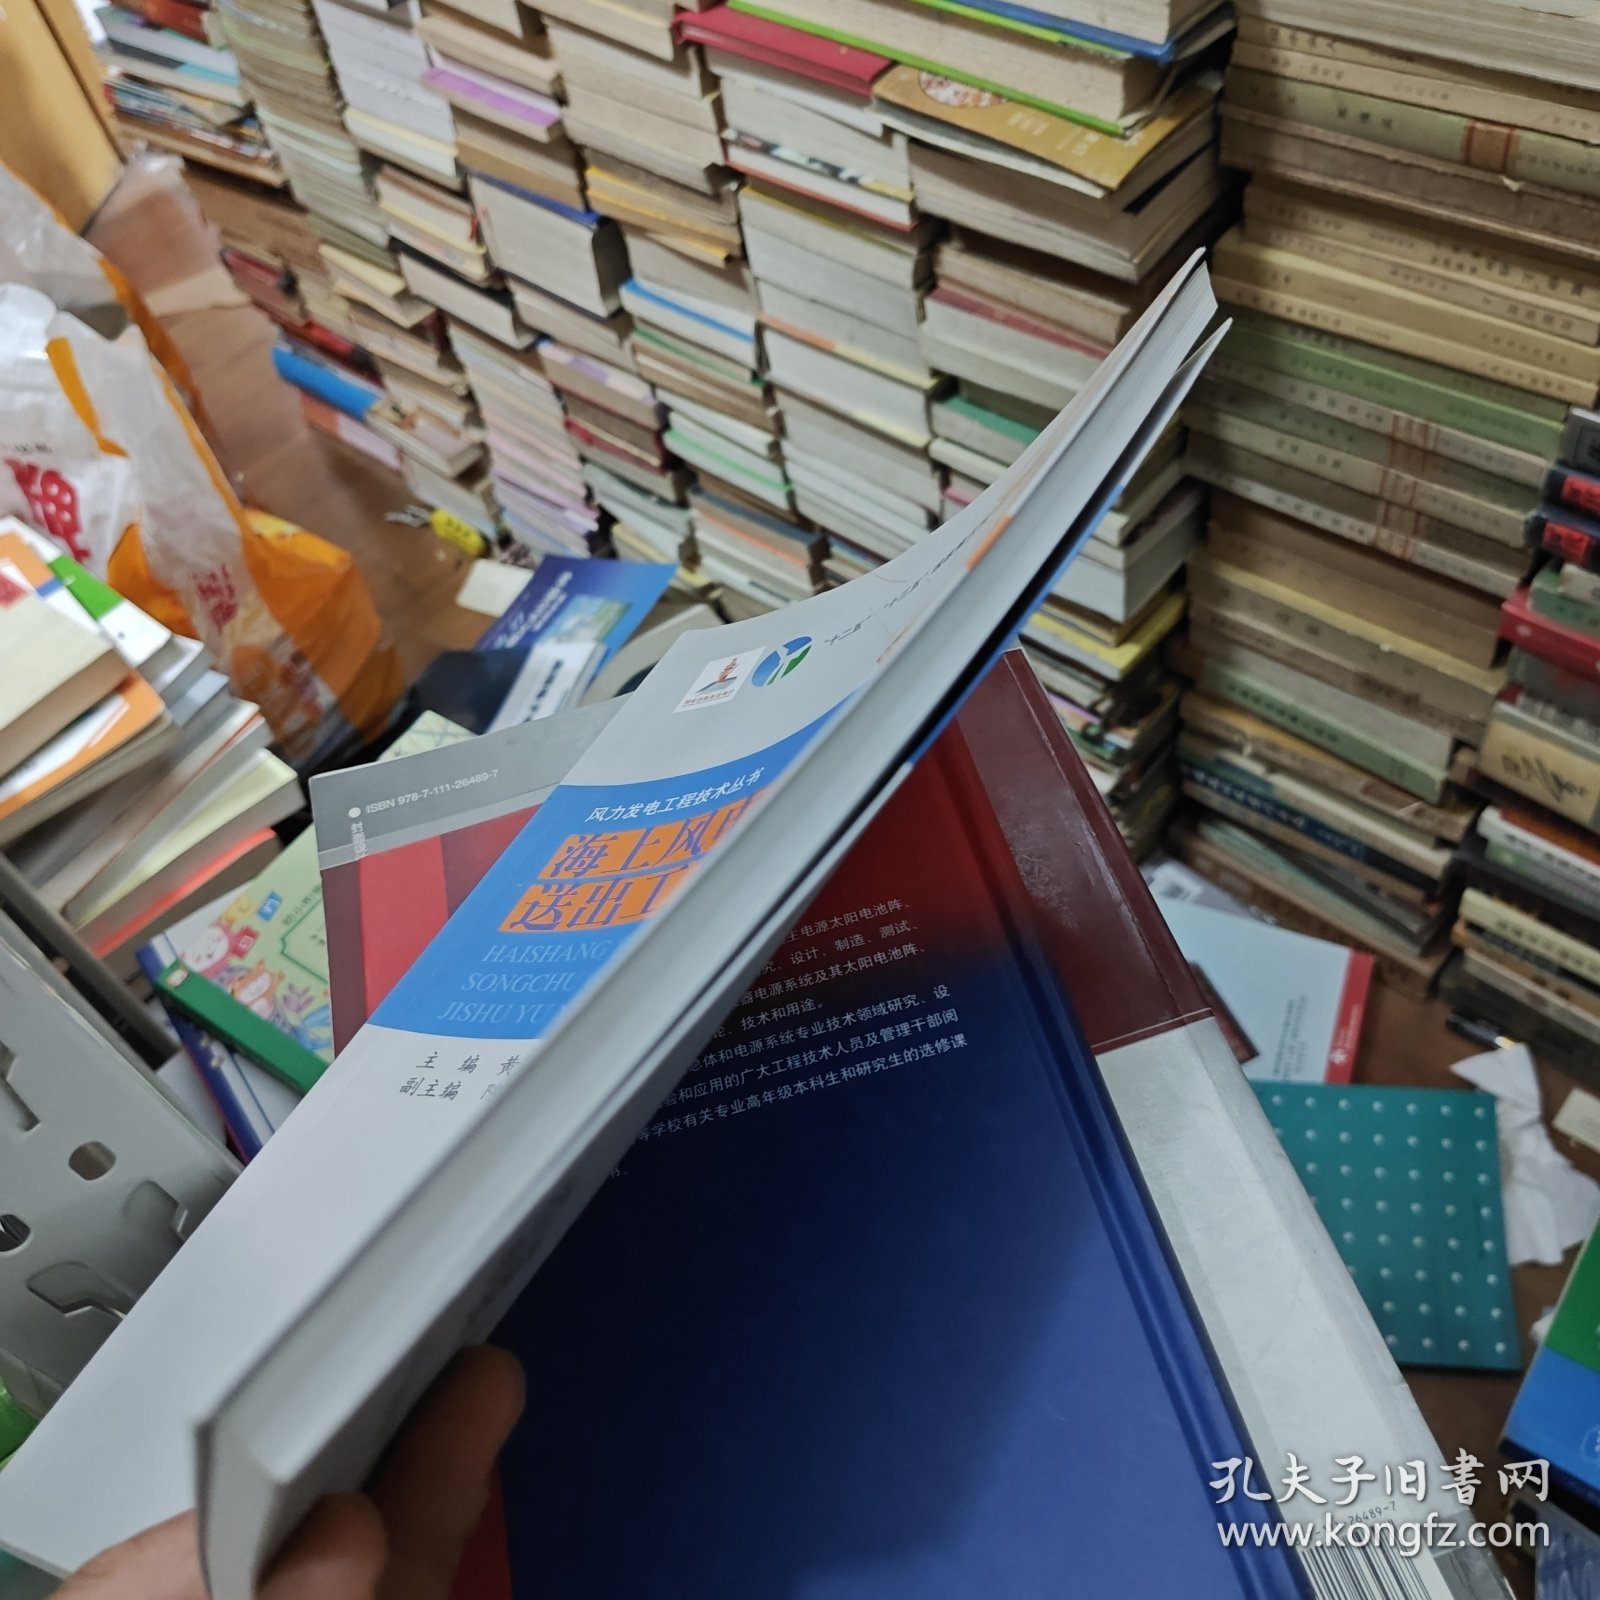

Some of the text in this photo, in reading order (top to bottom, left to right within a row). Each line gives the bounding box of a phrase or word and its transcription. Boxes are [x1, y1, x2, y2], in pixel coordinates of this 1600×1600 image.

[365, 769, 499, 814] ISBN 978-7-111-26489-7
[585, 767, 765, 823] 风力发电工程技术丛书
[481, 940, 612, 963] HAISHANG
[437, 1002, 514, 1024] JISHU
[400, 1077, 462, 1101] 副主编
